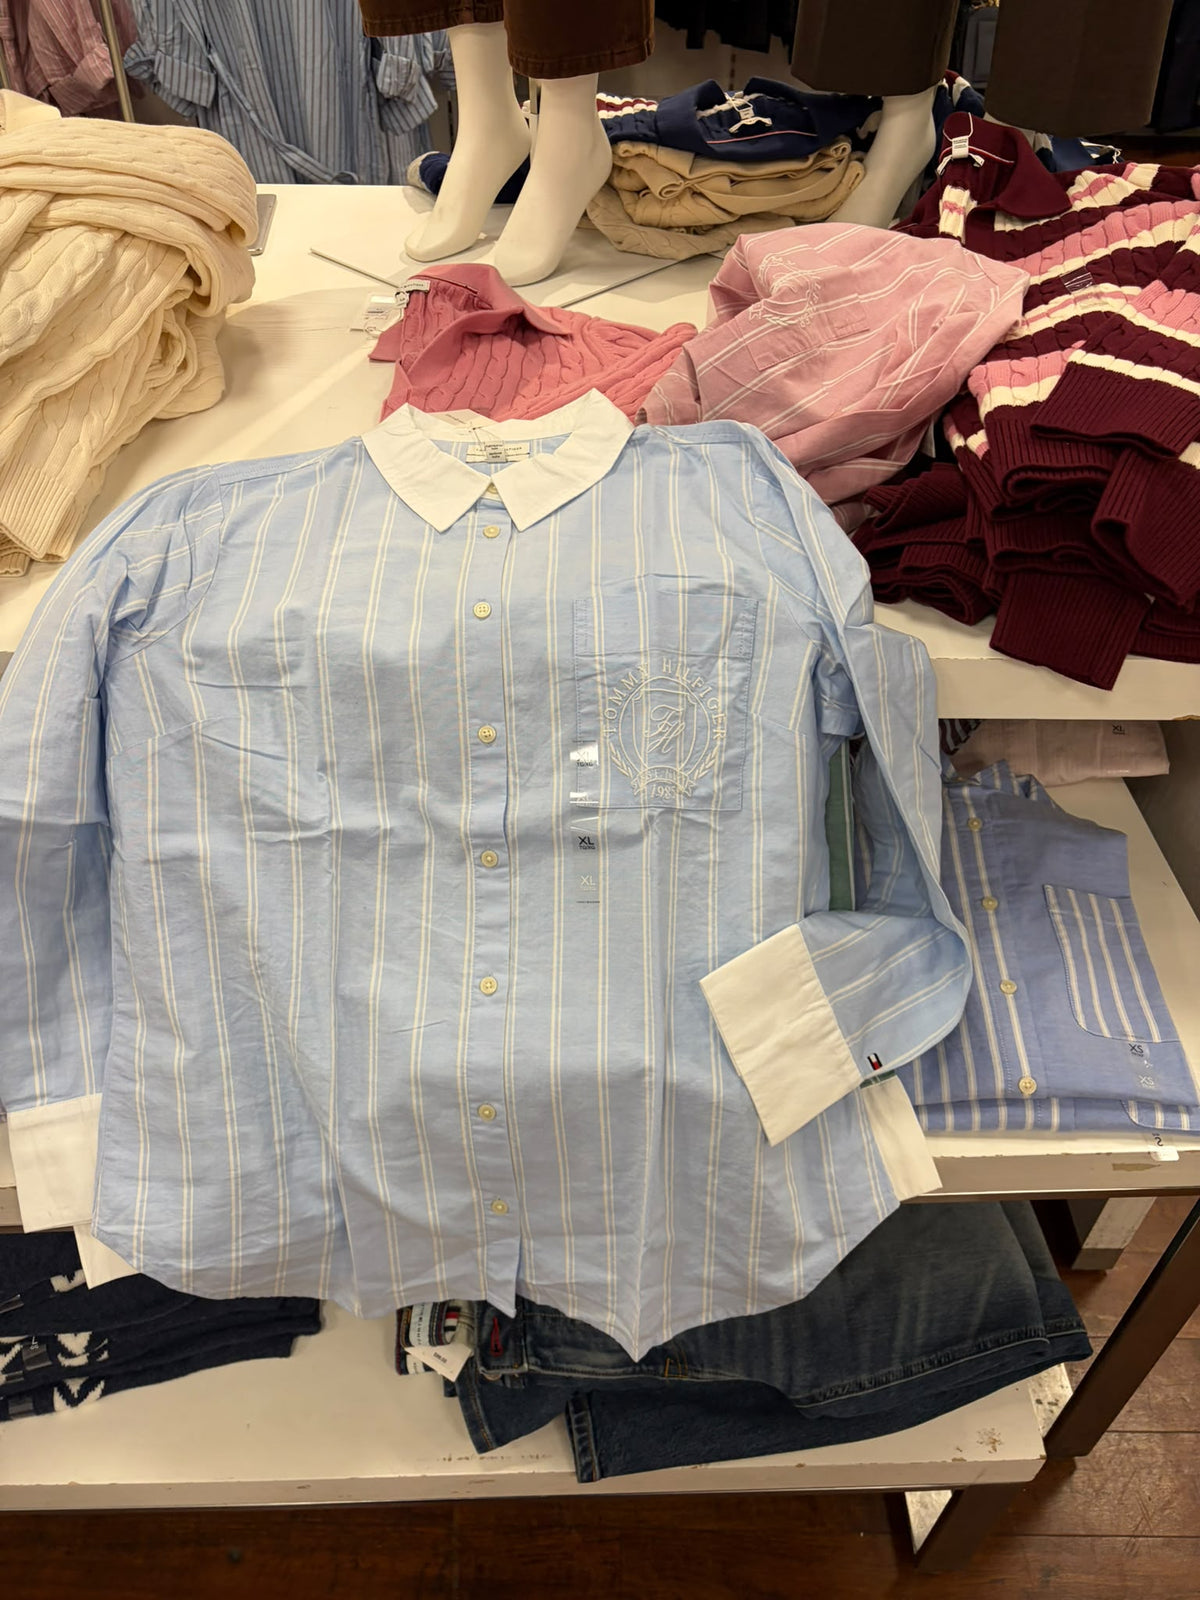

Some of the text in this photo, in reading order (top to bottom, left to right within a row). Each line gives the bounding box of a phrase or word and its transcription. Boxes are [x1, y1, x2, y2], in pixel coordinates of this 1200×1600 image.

[603, 657, 726, 739] TOMMY HILFIGER
[578, 835, 595, 846] XL
[580, 875, 596, 886] XL
[1128, 1043, 1144, 1054] XS
[1138, 1075, 1154, 1087] XS
